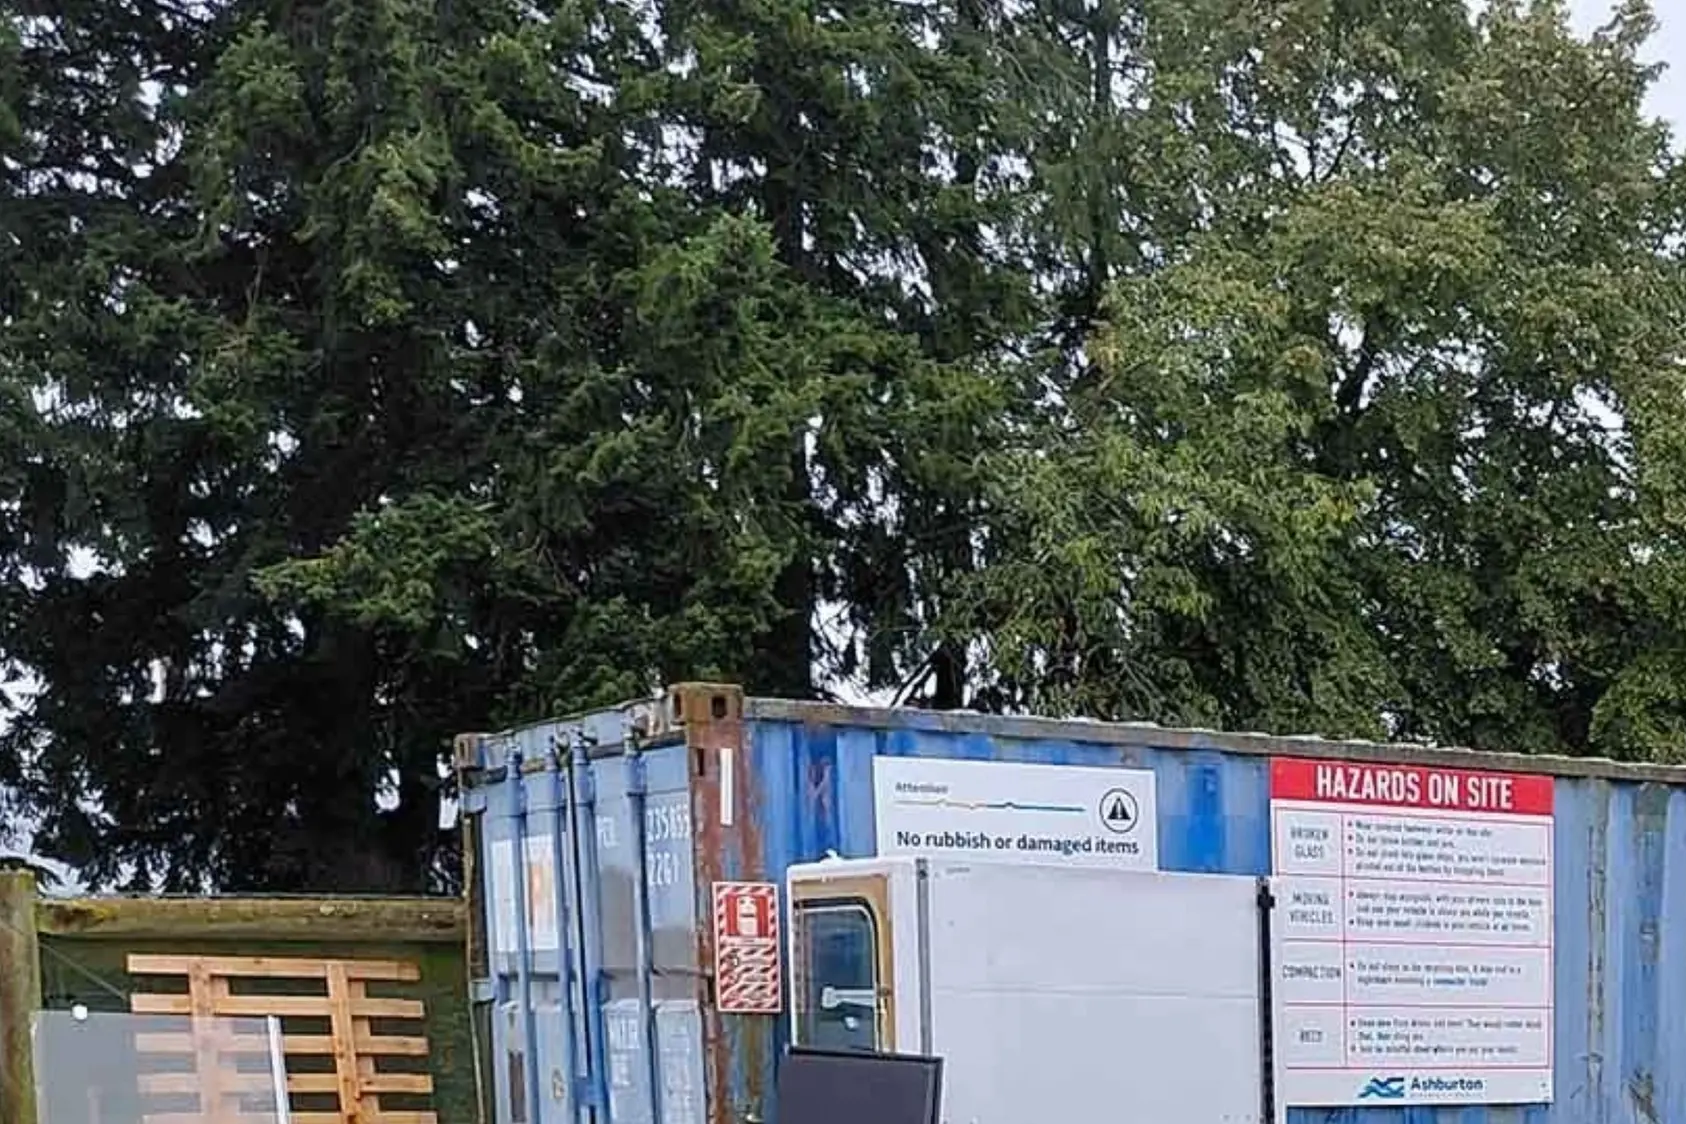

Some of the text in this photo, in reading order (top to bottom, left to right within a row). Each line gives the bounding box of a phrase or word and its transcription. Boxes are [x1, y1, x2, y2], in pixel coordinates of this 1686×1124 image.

[1316, 765, 1513, 809] HAZARDS ON SITE
[896, 831, 1140, 855] No rubbish or damaged items
[1410, 1077, 1484, 1092] Ashburton
